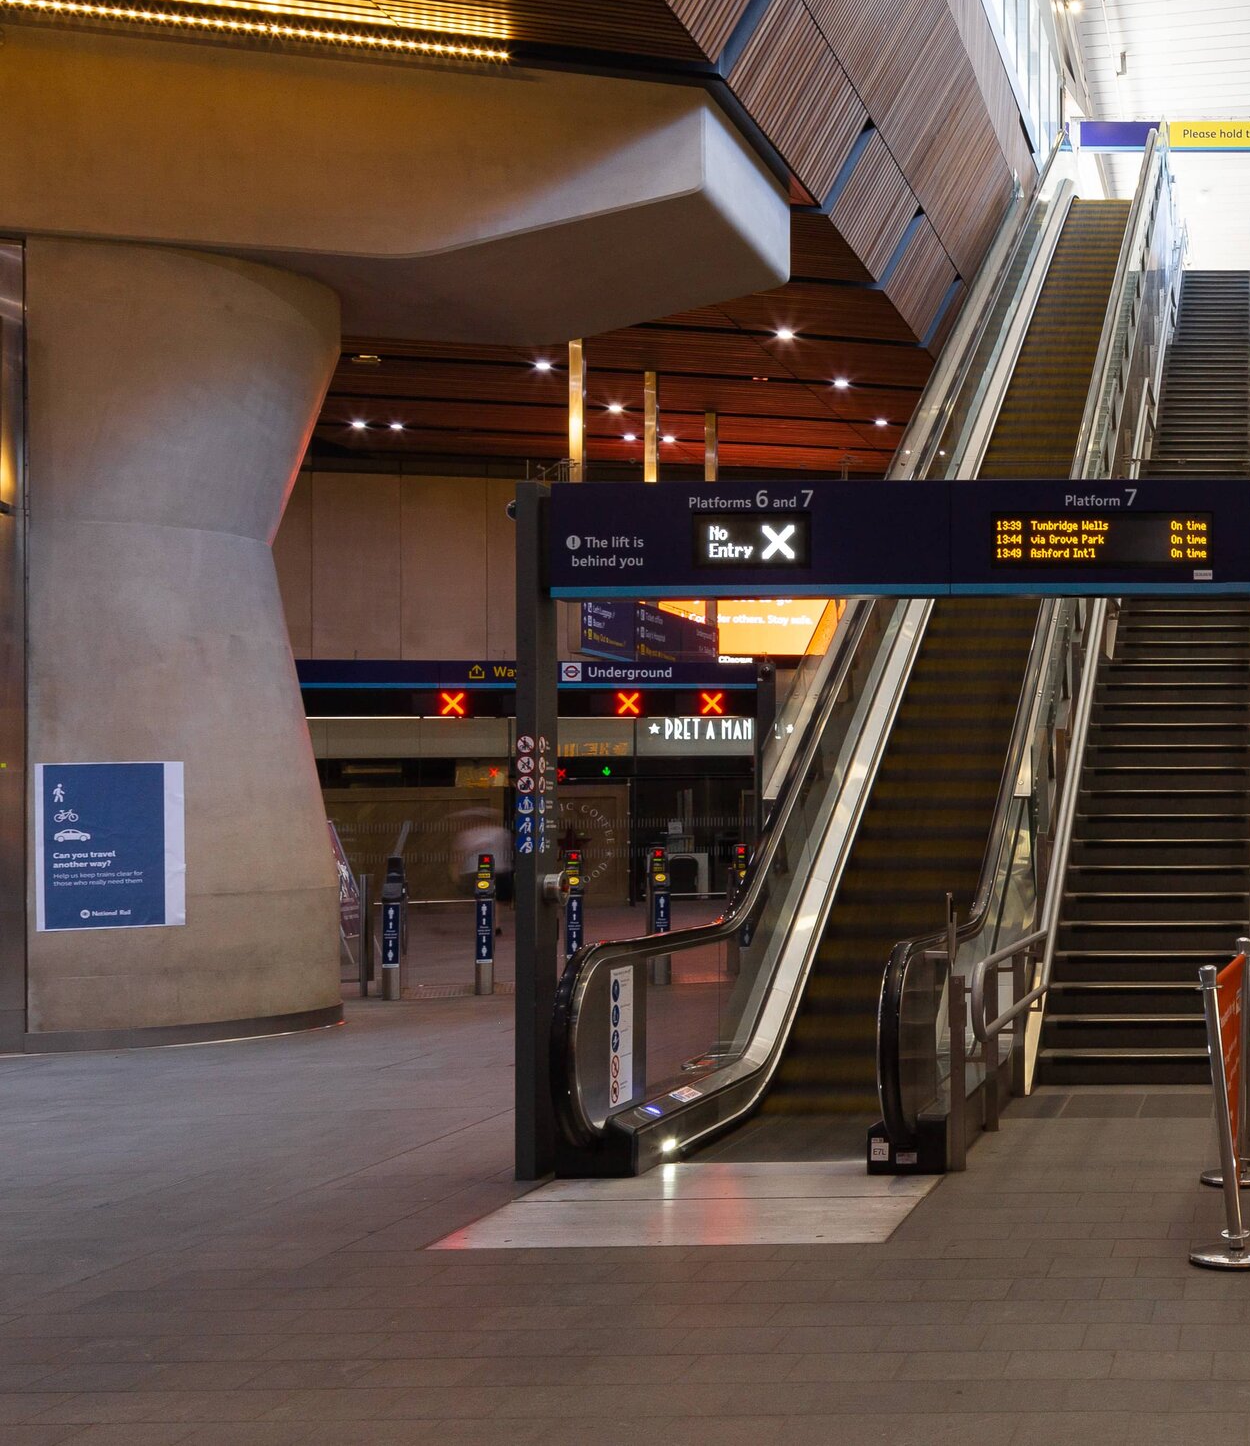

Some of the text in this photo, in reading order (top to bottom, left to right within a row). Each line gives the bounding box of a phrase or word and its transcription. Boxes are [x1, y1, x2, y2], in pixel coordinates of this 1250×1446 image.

[1183, 129, 1217, 139] Please
[1219, 129, 1242, 139] hold
[688, 490, 814, 509] Platforms 6 and 7
[1065, 489, 1138, 507] Platform 7
[996, 521, 1207, 532] 13:39 Tunbridge Wells On time
[709, 526, 728, 541] No
[585, 536, 644, 548] The lift is
[996, 535, 1207, 545] 13:44 via Grove Park On time
[709, 543, 753, 559] Entry
[996, 548, 1207, 558] 13:49 Ashford Int'l On time
[571, 555, 644, 569] behind you
[767, 614, 789, 626] Stay
[588, 666, 673, 680] Underground
[665, 718, 700, 740] PRET
[706, 720, 715, 740] A
[721, 718, 752, 740] MAN
[72, 852, 88, 860] you
[90, 850, 116, 858] travel
[89, 860, 111, 869] way?
[80, 872, 95, 880] keep
[582, 862, 608, 883] OOD
